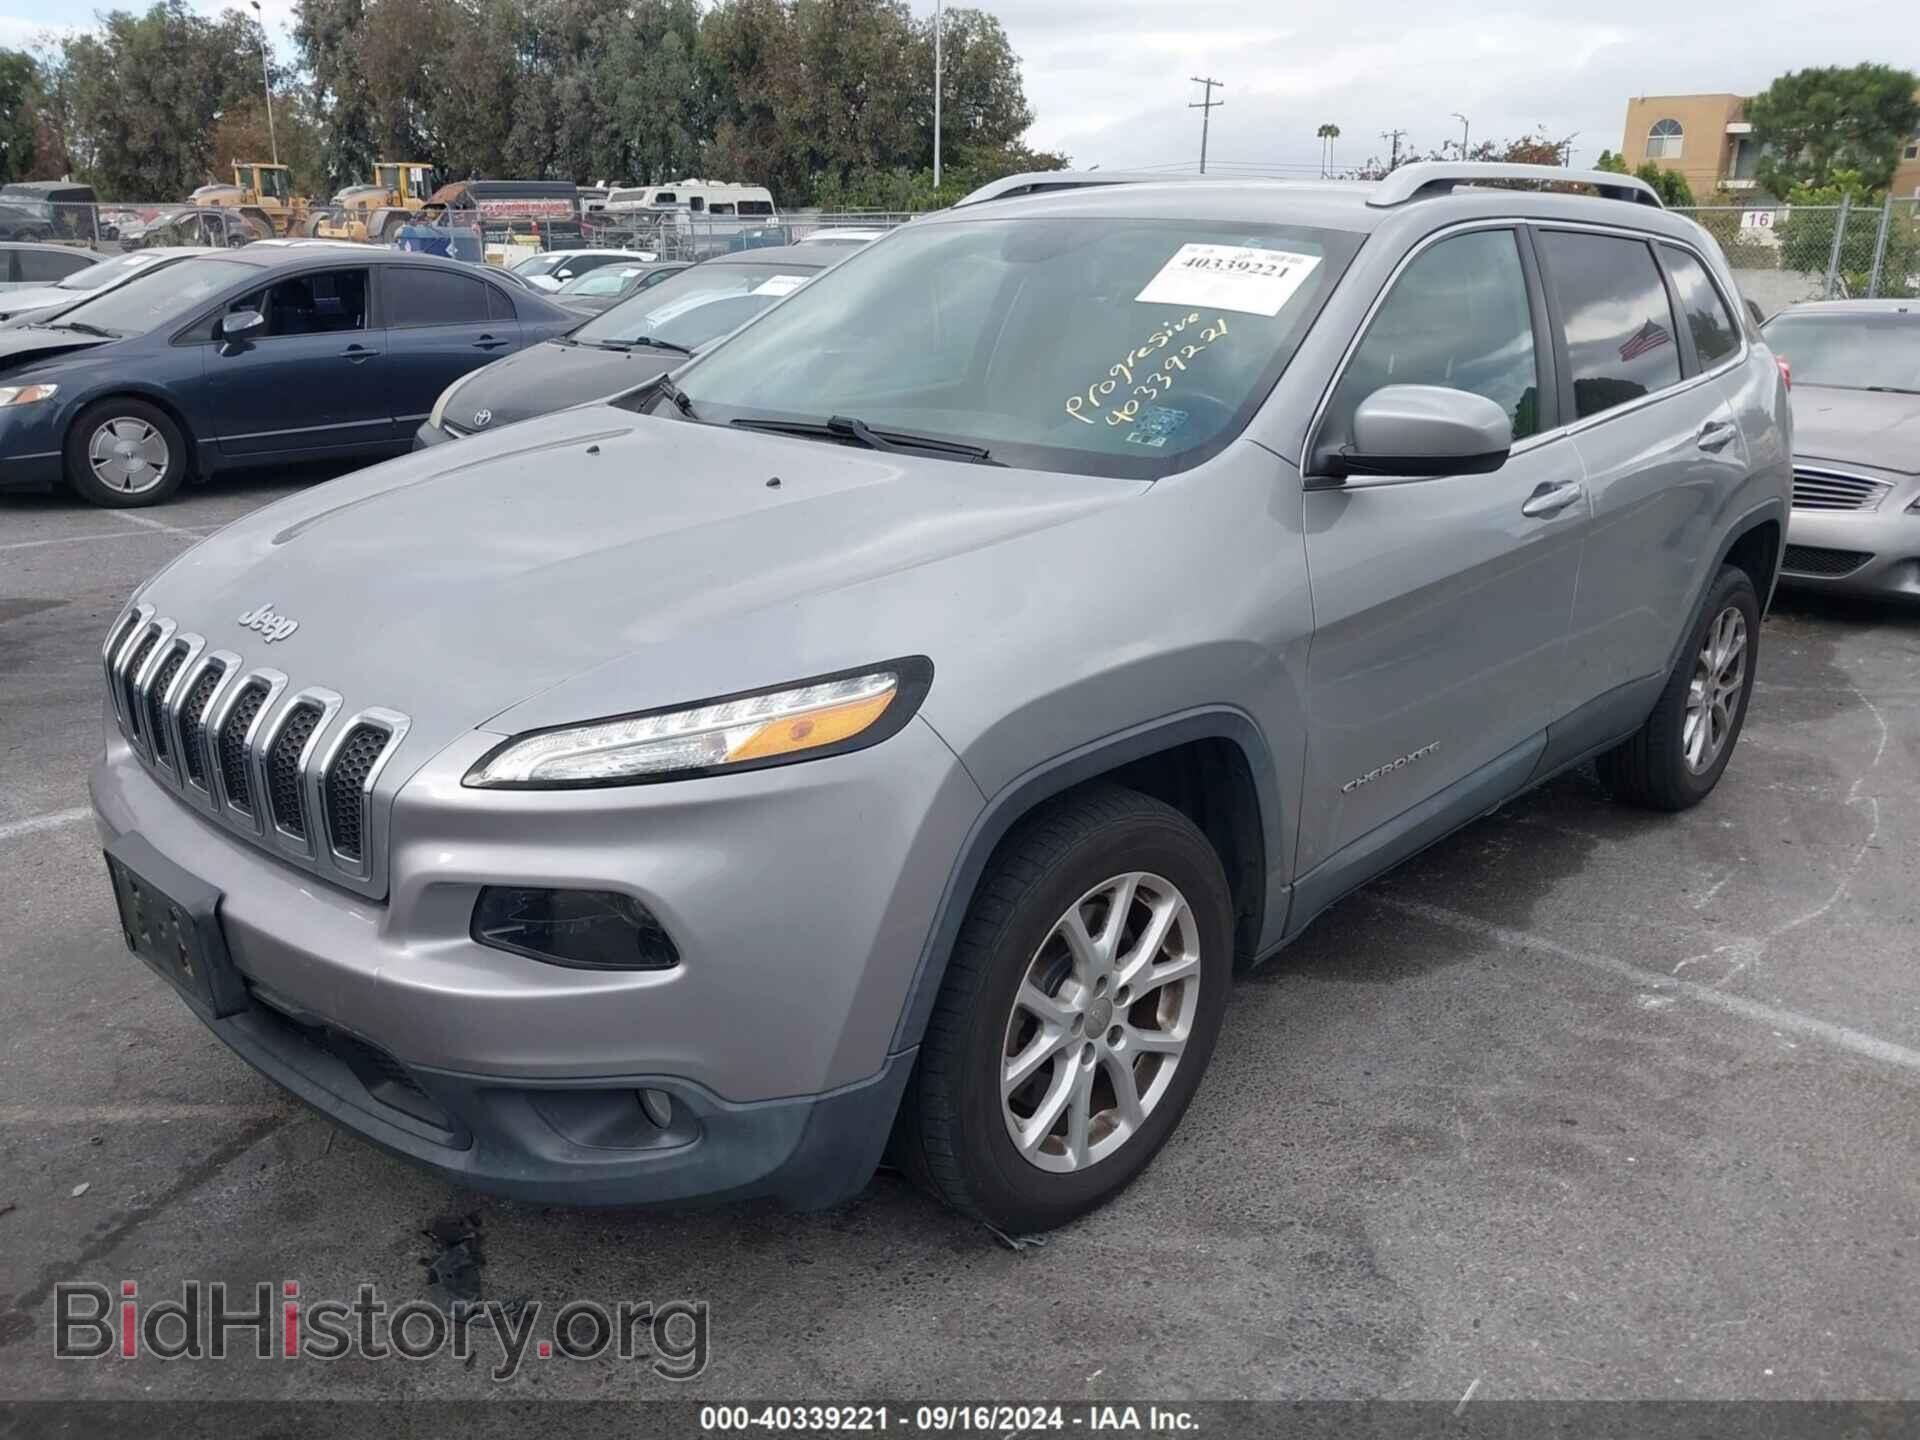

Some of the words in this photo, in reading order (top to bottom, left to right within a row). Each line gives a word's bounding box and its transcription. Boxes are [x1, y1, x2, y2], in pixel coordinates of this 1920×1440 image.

[1749, 213, 1769, 226] 16
[1182, 257, 1290, 278] 40339221
[1105, 318, 1228, 425] 40339221
[238, 603, 299, 644] Jeep
